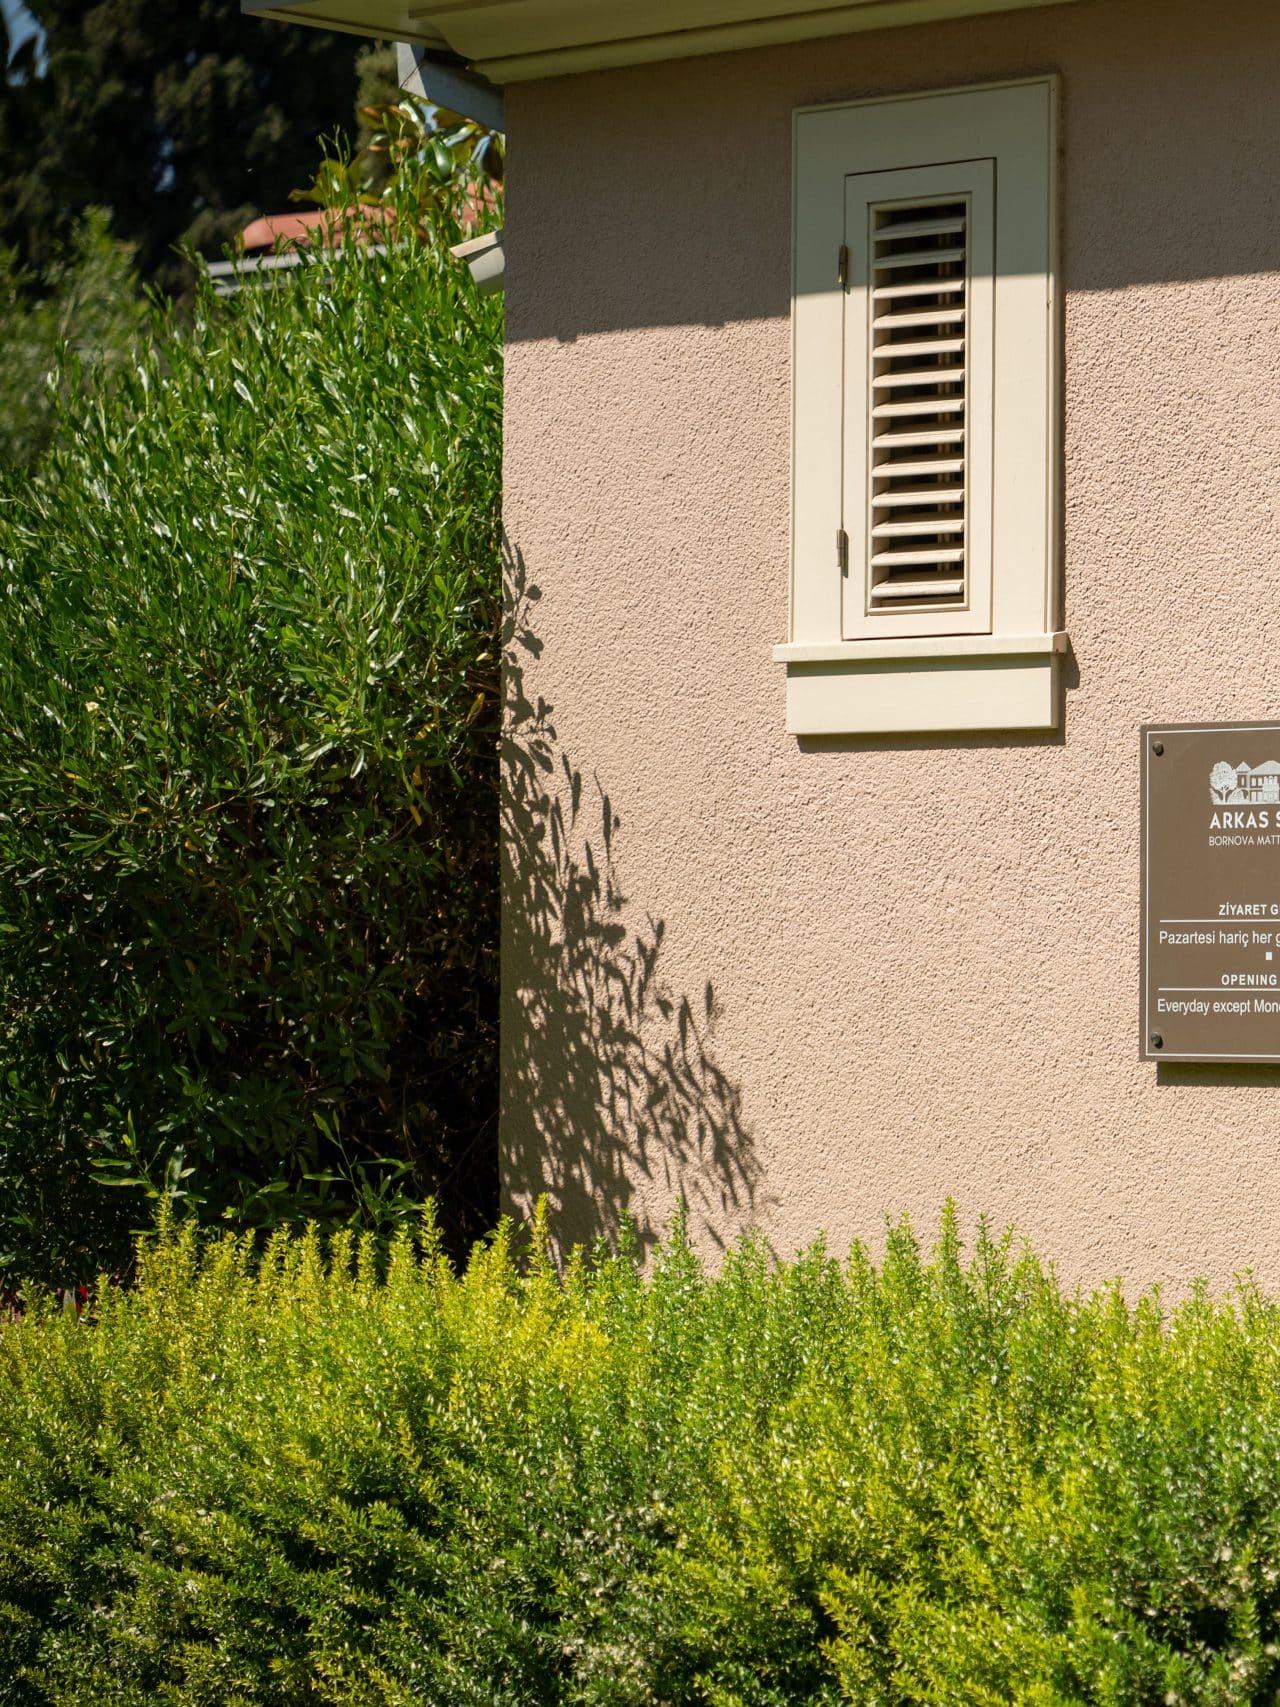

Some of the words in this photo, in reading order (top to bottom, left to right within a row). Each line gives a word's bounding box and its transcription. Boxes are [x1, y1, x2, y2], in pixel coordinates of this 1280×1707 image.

[1209, 811, 1269, 829] ARKAS
[1208, 835, 1255, 846] BORNOVA
[1218, 902, 1267, 916] ZİYARET
[1159, 931, 1216, 945] Pazartesi
[1219, 931, 1249, 948] hariç
[1252, 931, 1272, 944] her
[1221, 974, 1278, 986] OPENING
[1157, 998, 1210, 1016] Everyday
[1213, 999, 1251, 1016] except
